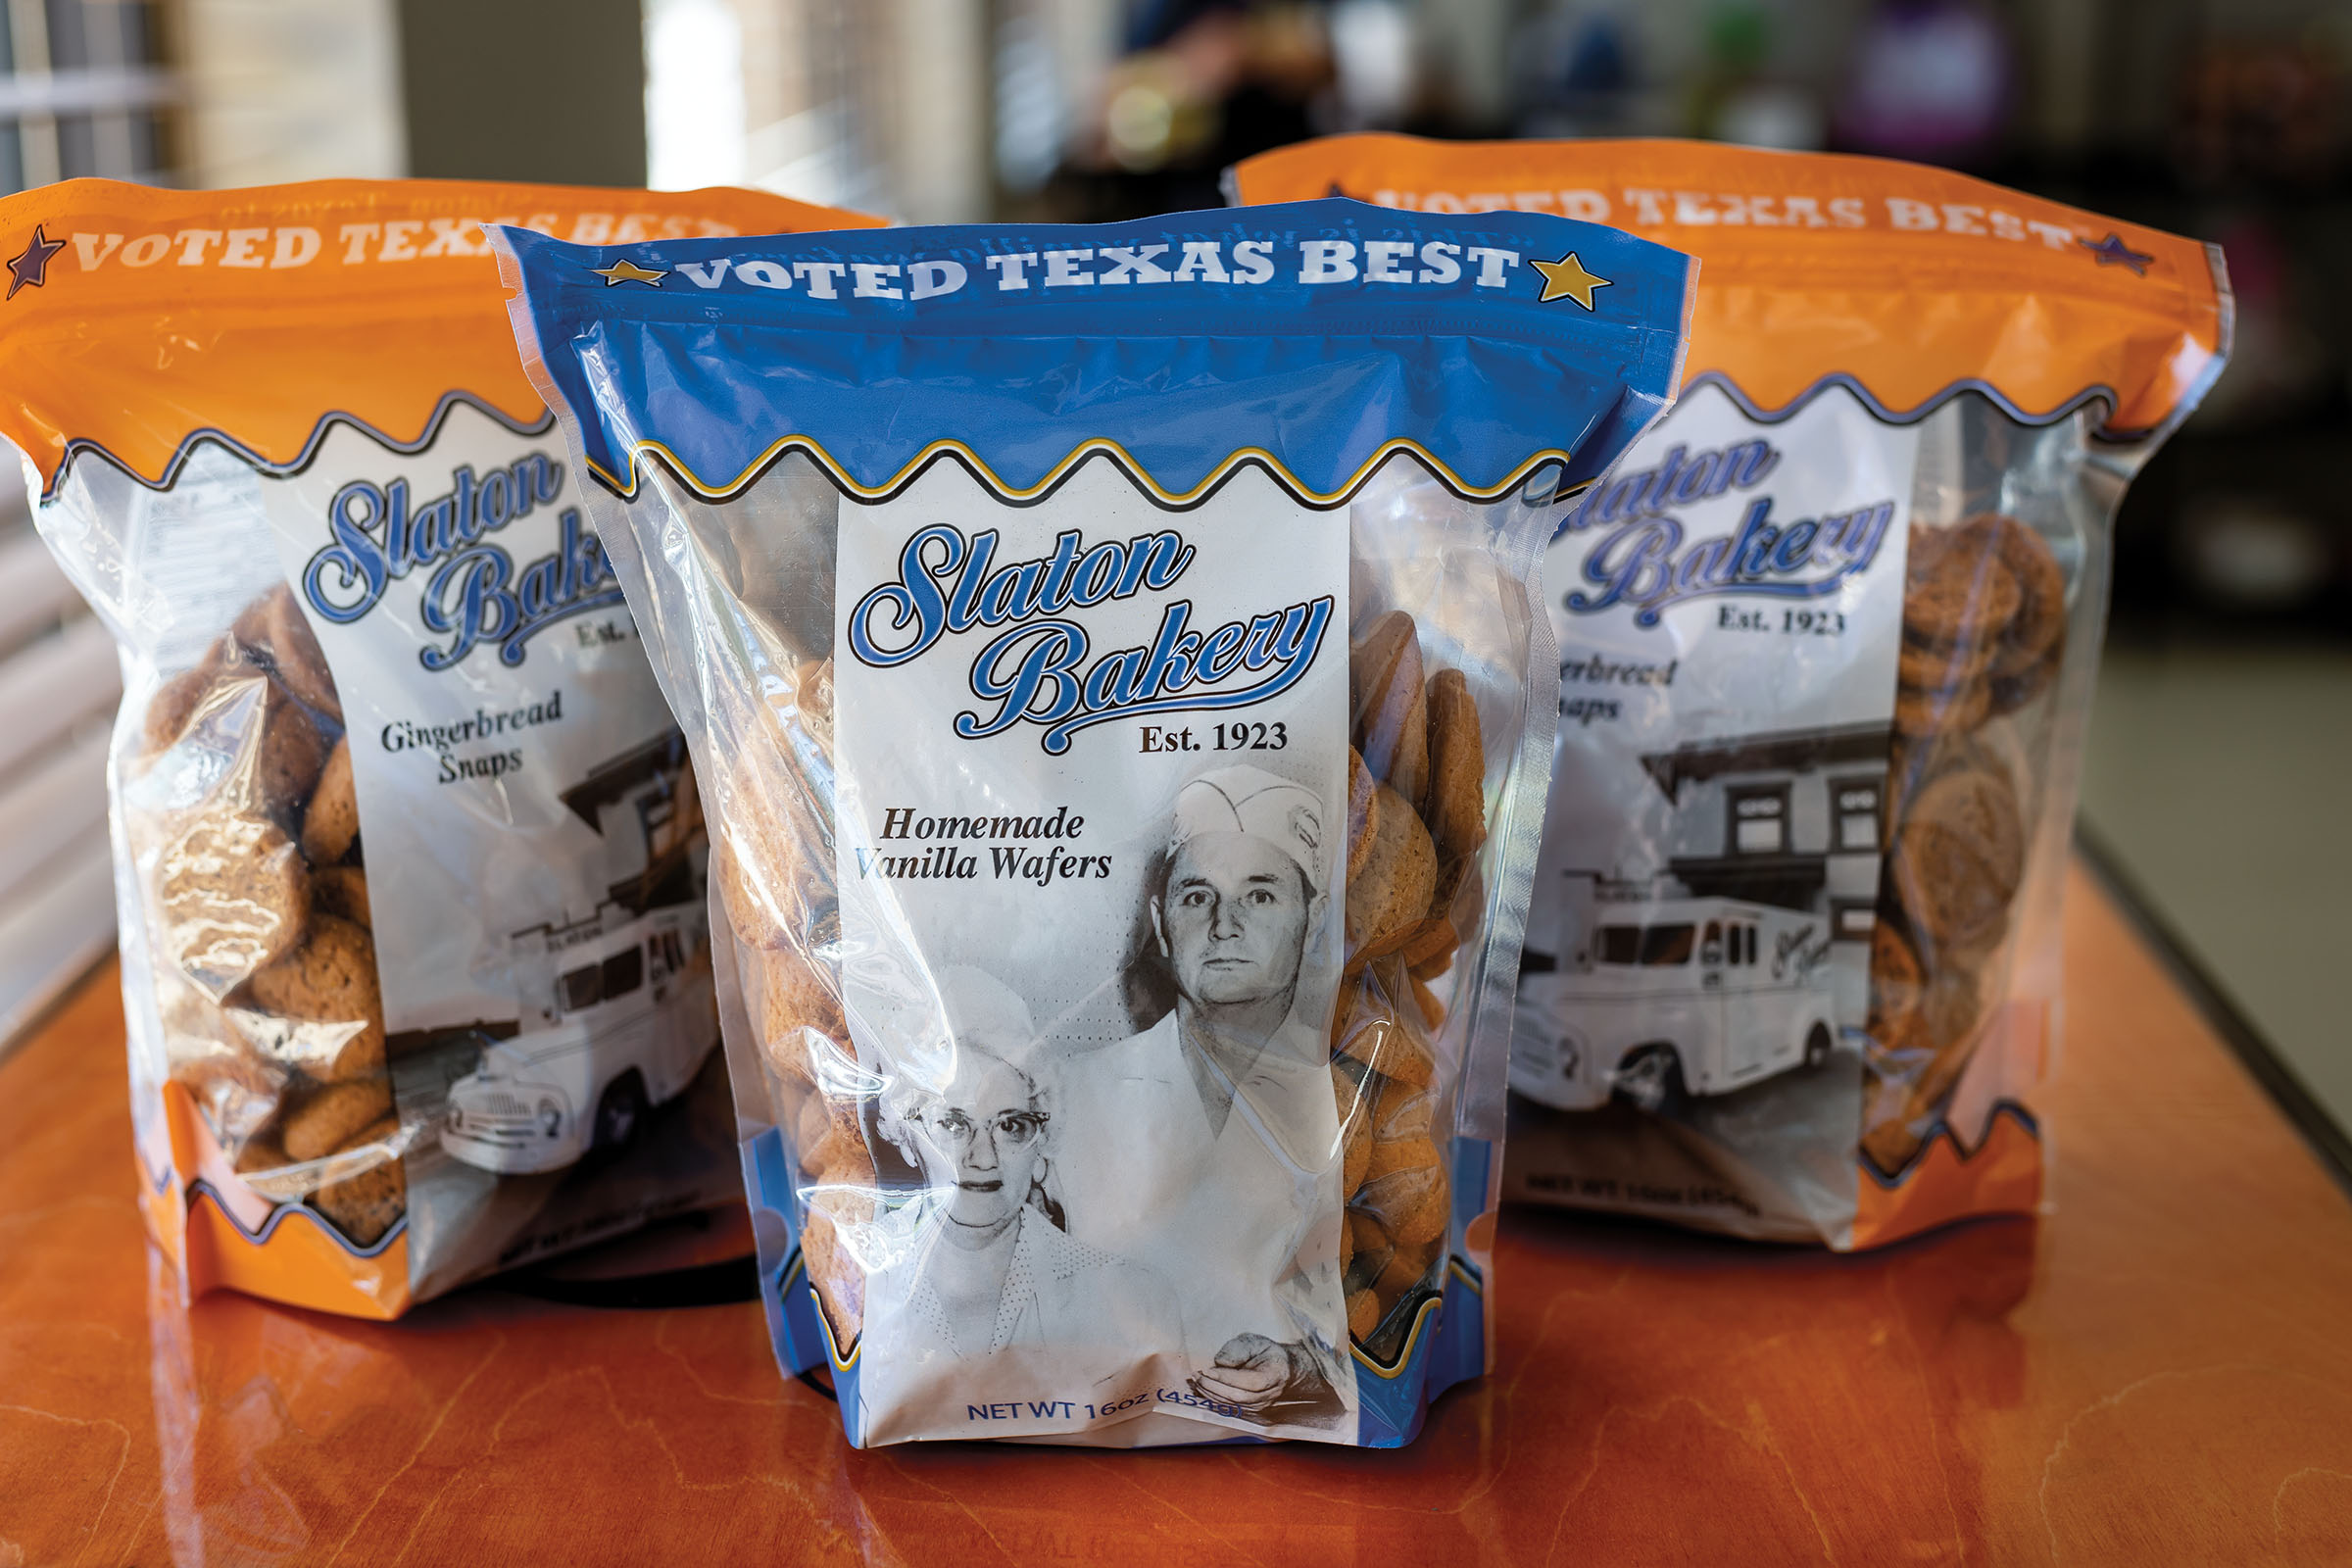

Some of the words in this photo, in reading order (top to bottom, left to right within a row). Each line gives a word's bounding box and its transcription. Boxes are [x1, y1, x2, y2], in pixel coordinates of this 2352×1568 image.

[72, 226, 322, 271] VOTED
[1624, 188, 1866, 228] TEXAS
[1885, 198, 2074, 251] BEST
[674, 258, 968, 300] VOTED
[985, 240, 1275, 291] TEXAS
[1298, 240, 1520, 288] BEST
[1548, 439, 1782, 545] laton
[302, 450, 565, 624] Slaton
[1563, 493, 1895, 630] Bakery
[849, 522, 1198, 668] Slaton
[1717, 605, 1773, 632] Est.
[1782, 608, 1846, 635] 1923
[953, 594, 1335, 756] Bakery
[380, 689, 565, 754] Gingerbread
[1138, 725, 1202, 754] Est.
[1212, 722, 1289, 753] 1923
[439, 748, 524, 784] Snaps
[879, 806, 1085, 841] Homemade
[855, 846, 978, 880] Vanilla
[988, 846, 1112, 887] Wafers
[967, 1402, 1023, 1420] NET
[1026, 1401, 1076, 1419] WT
[1084, 1393, 1150, 1419] 16oz
[1155, 1388, 1244, 1419] (454g)
